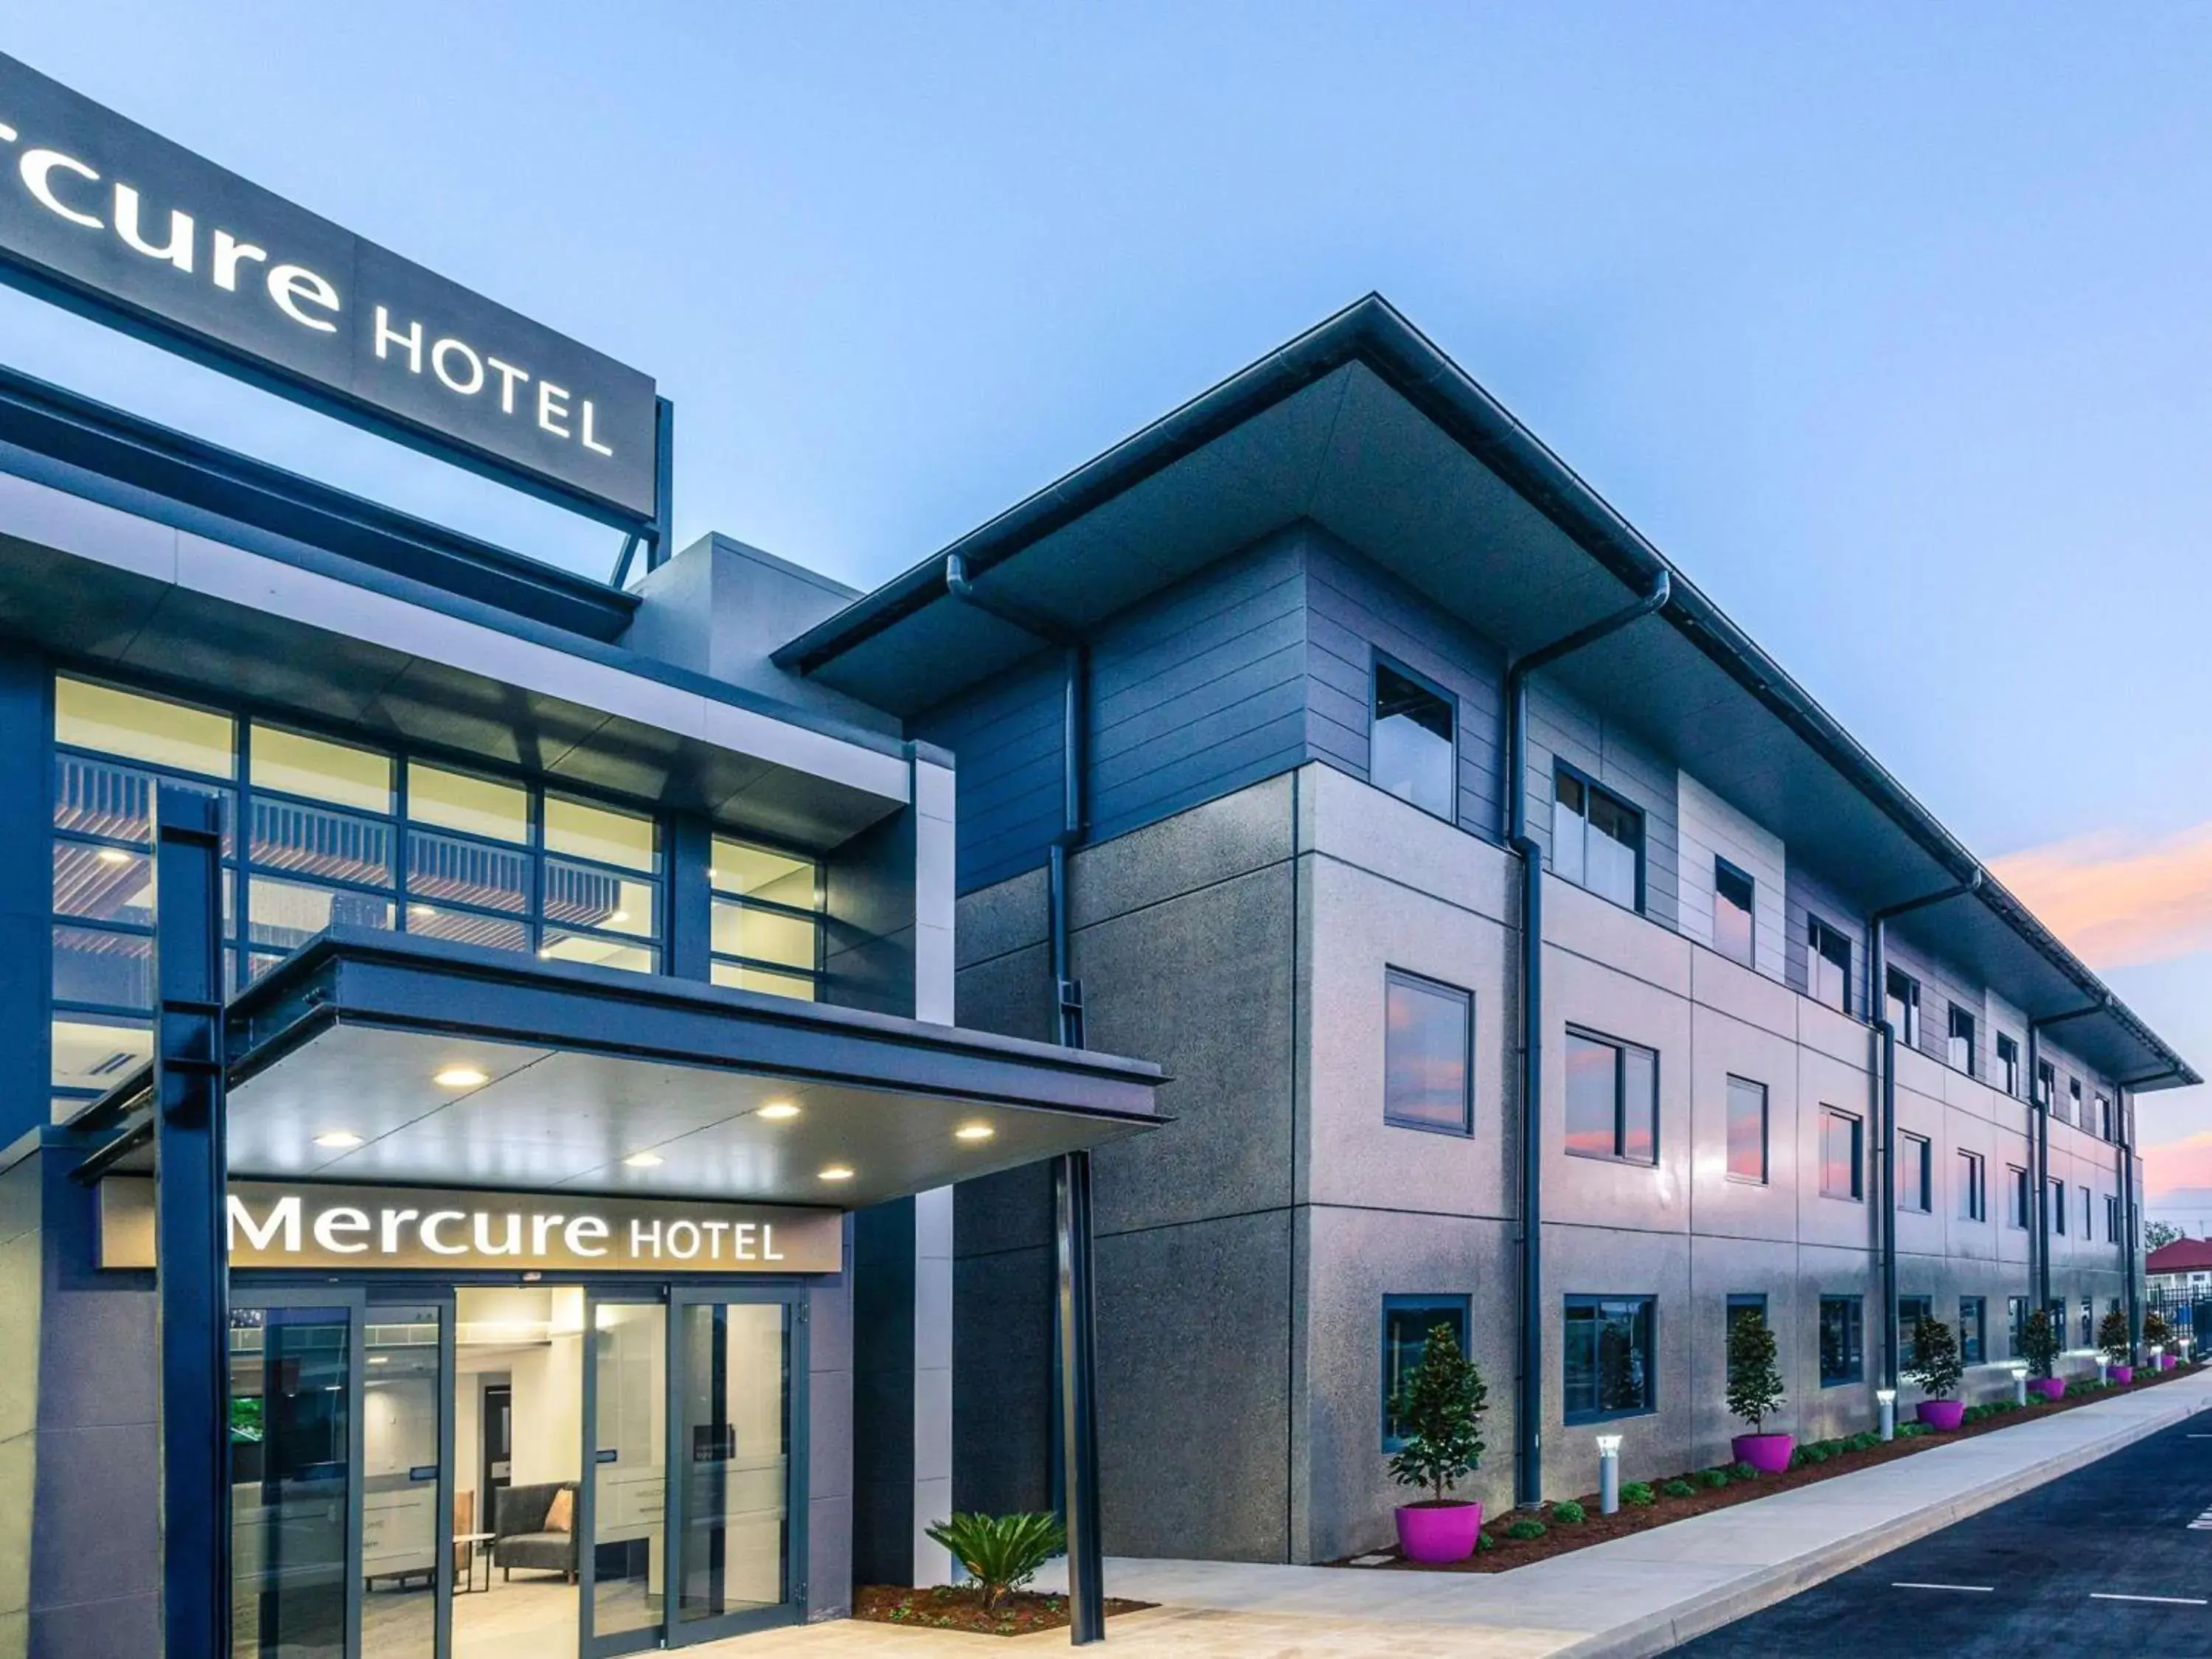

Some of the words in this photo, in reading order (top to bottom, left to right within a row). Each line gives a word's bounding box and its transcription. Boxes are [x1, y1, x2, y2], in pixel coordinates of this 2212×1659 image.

[375, 305, 613, 457] HOTEL
[226, 1194, 609, 1257] Mercure
[630, 1219, 785, 1260] HOTEL
